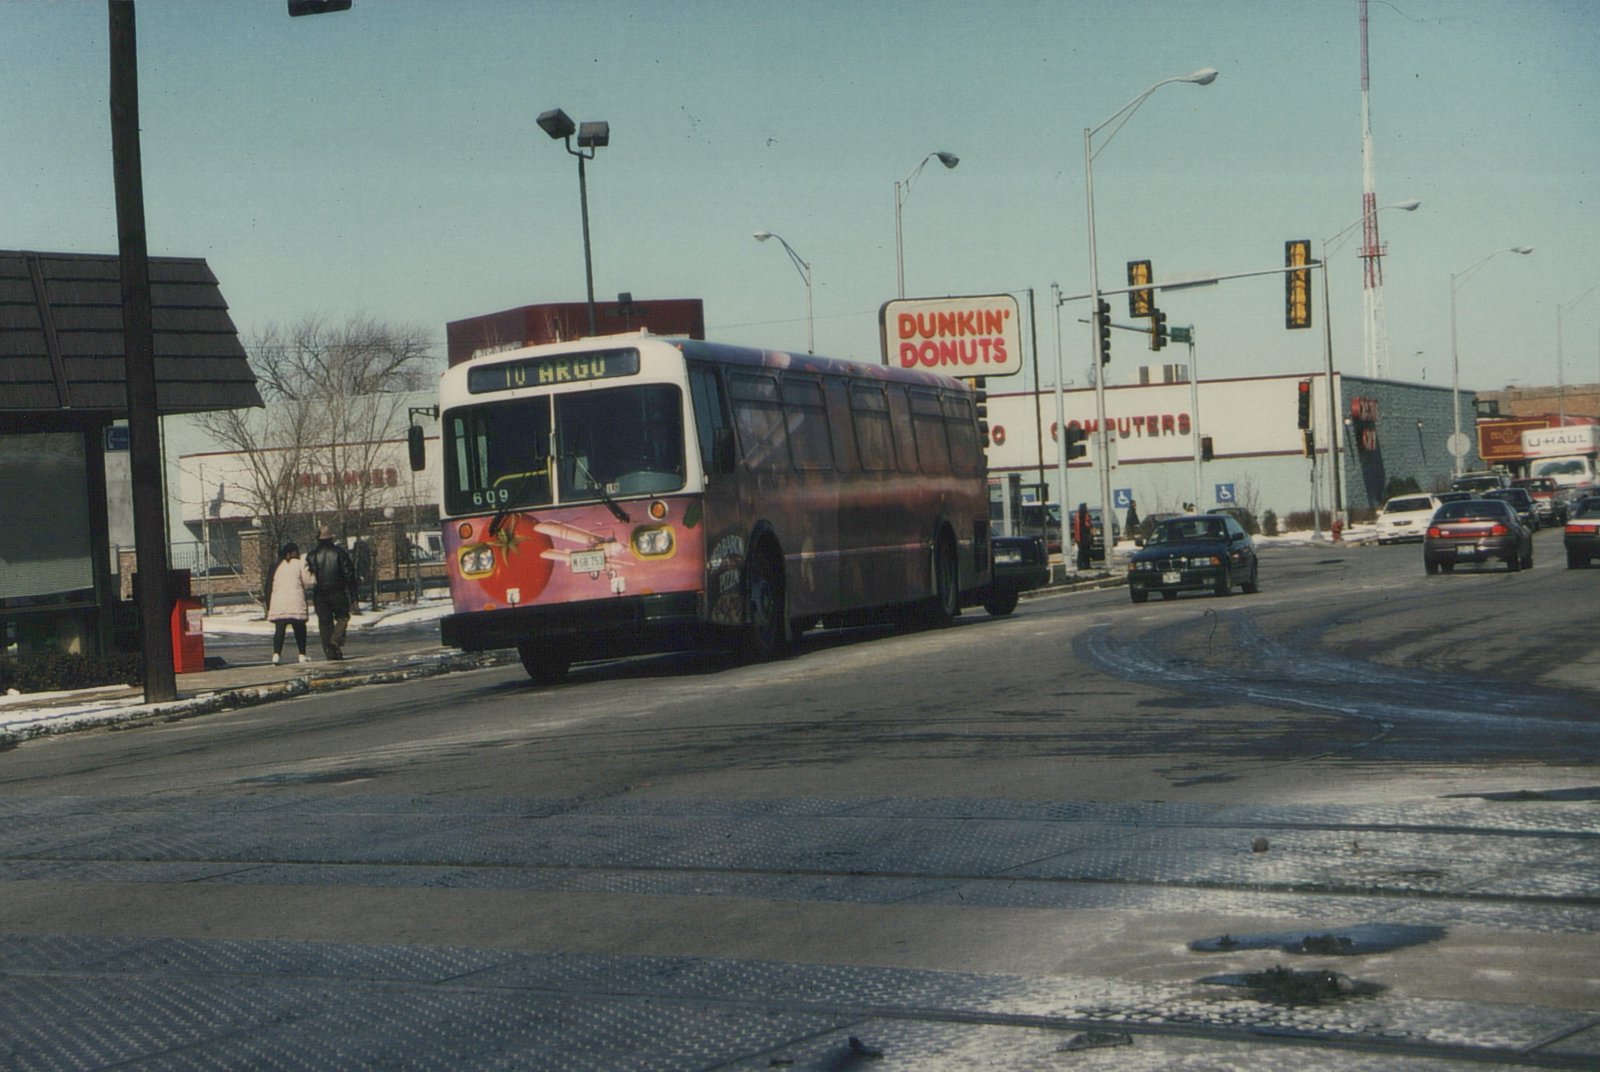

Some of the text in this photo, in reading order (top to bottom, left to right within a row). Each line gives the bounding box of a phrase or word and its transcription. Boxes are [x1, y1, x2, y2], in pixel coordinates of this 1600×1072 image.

[897, 308, 1010, 339] DUNKIN'
[899, 338, 1008, 369] DONUTS
[472, 488, 509, 505] 609
